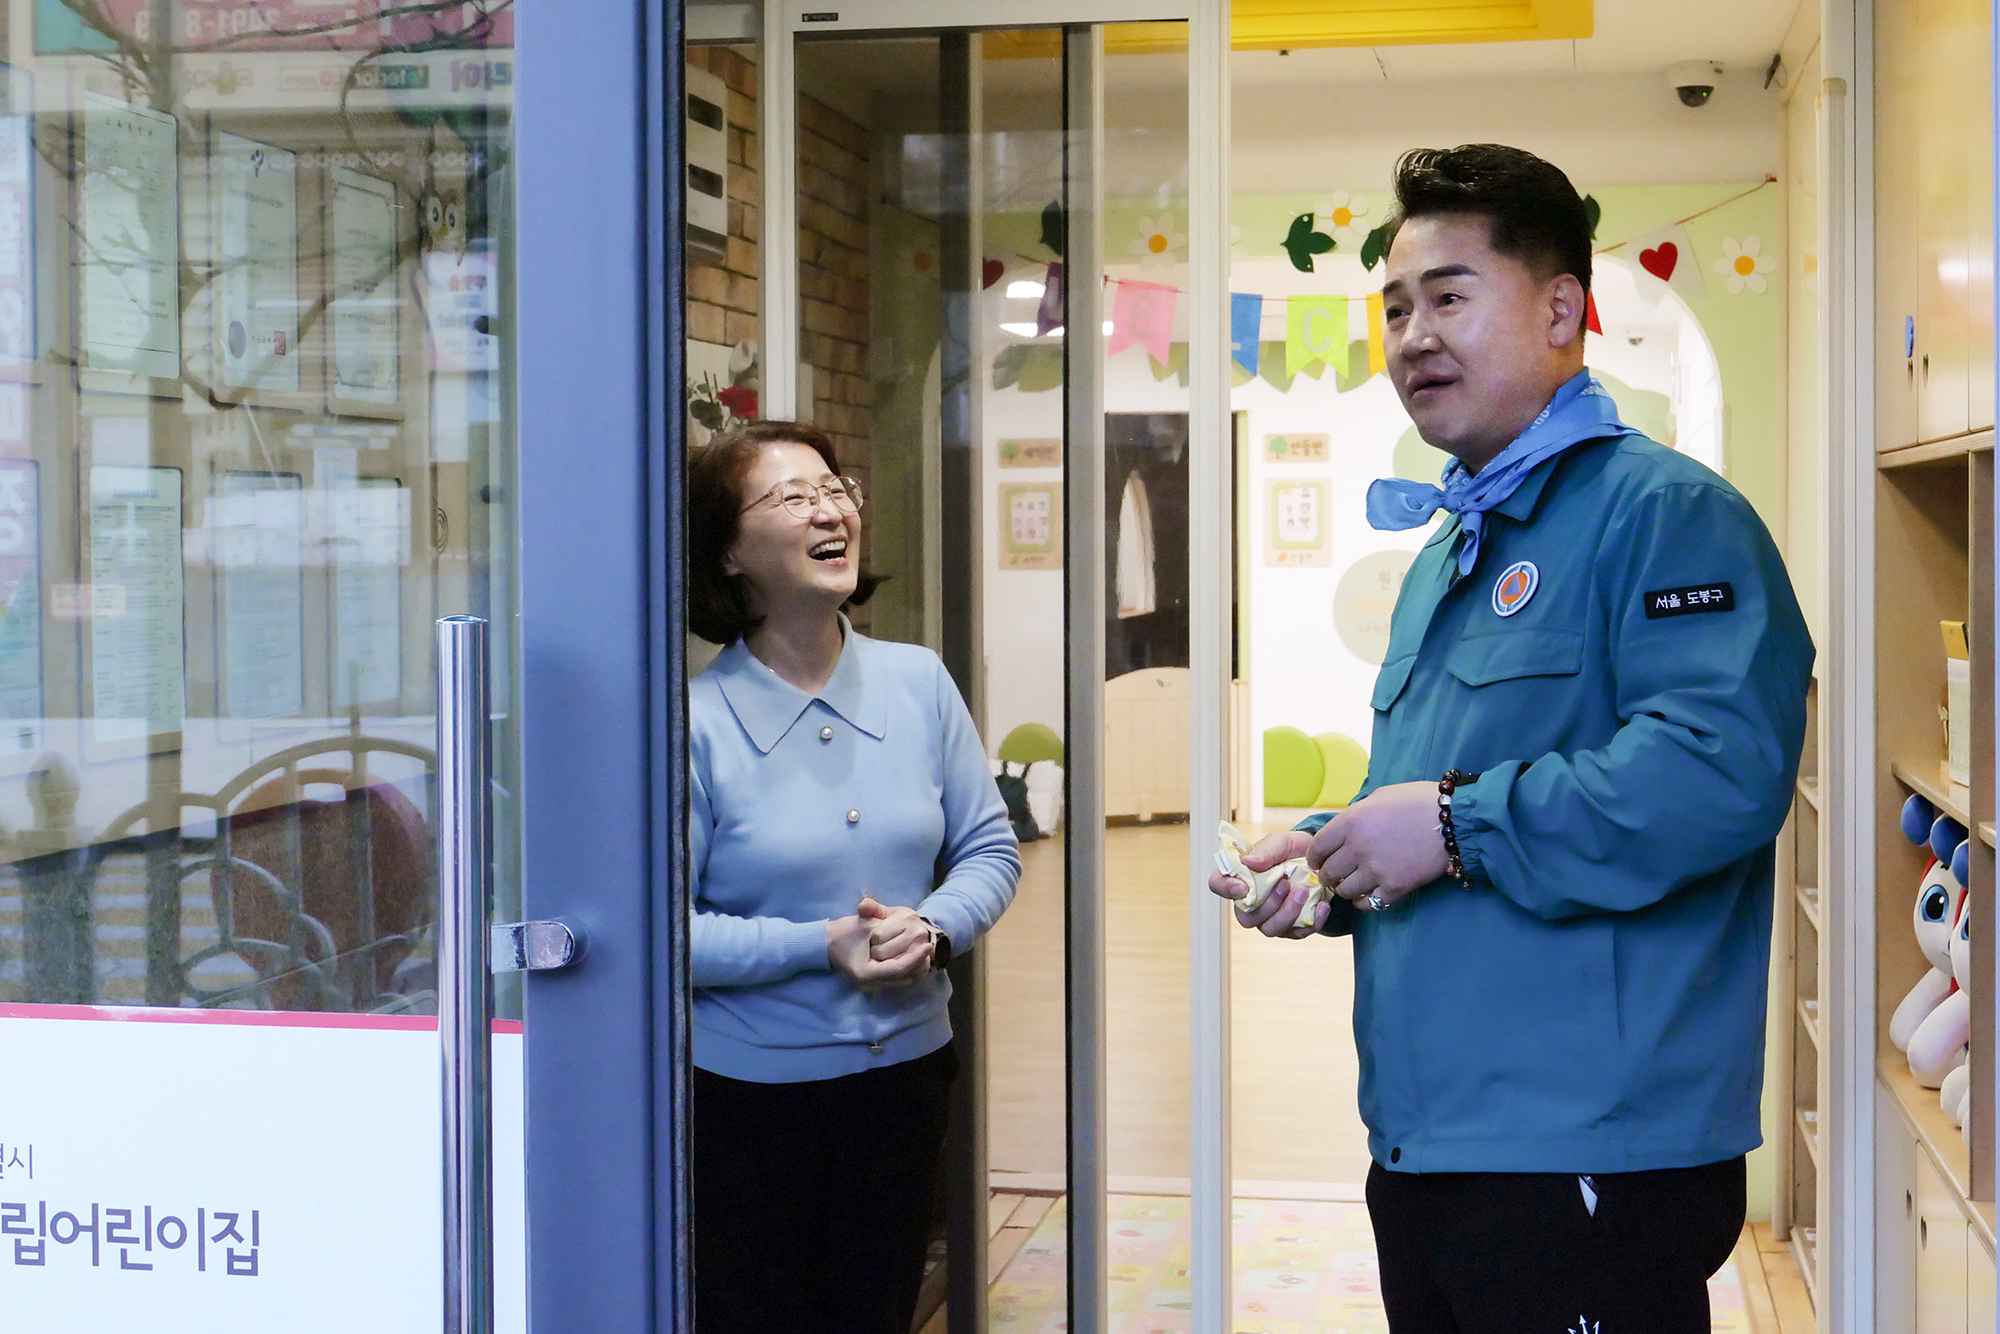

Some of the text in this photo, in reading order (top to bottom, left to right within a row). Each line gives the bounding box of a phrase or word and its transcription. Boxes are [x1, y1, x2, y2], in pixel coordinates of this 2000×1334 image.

[1655, 589, 1724, 609] 서울 도봉구
[0, 1143, 33, 1180] 시
[1, 1200, 260, 1277] 립어린이집
